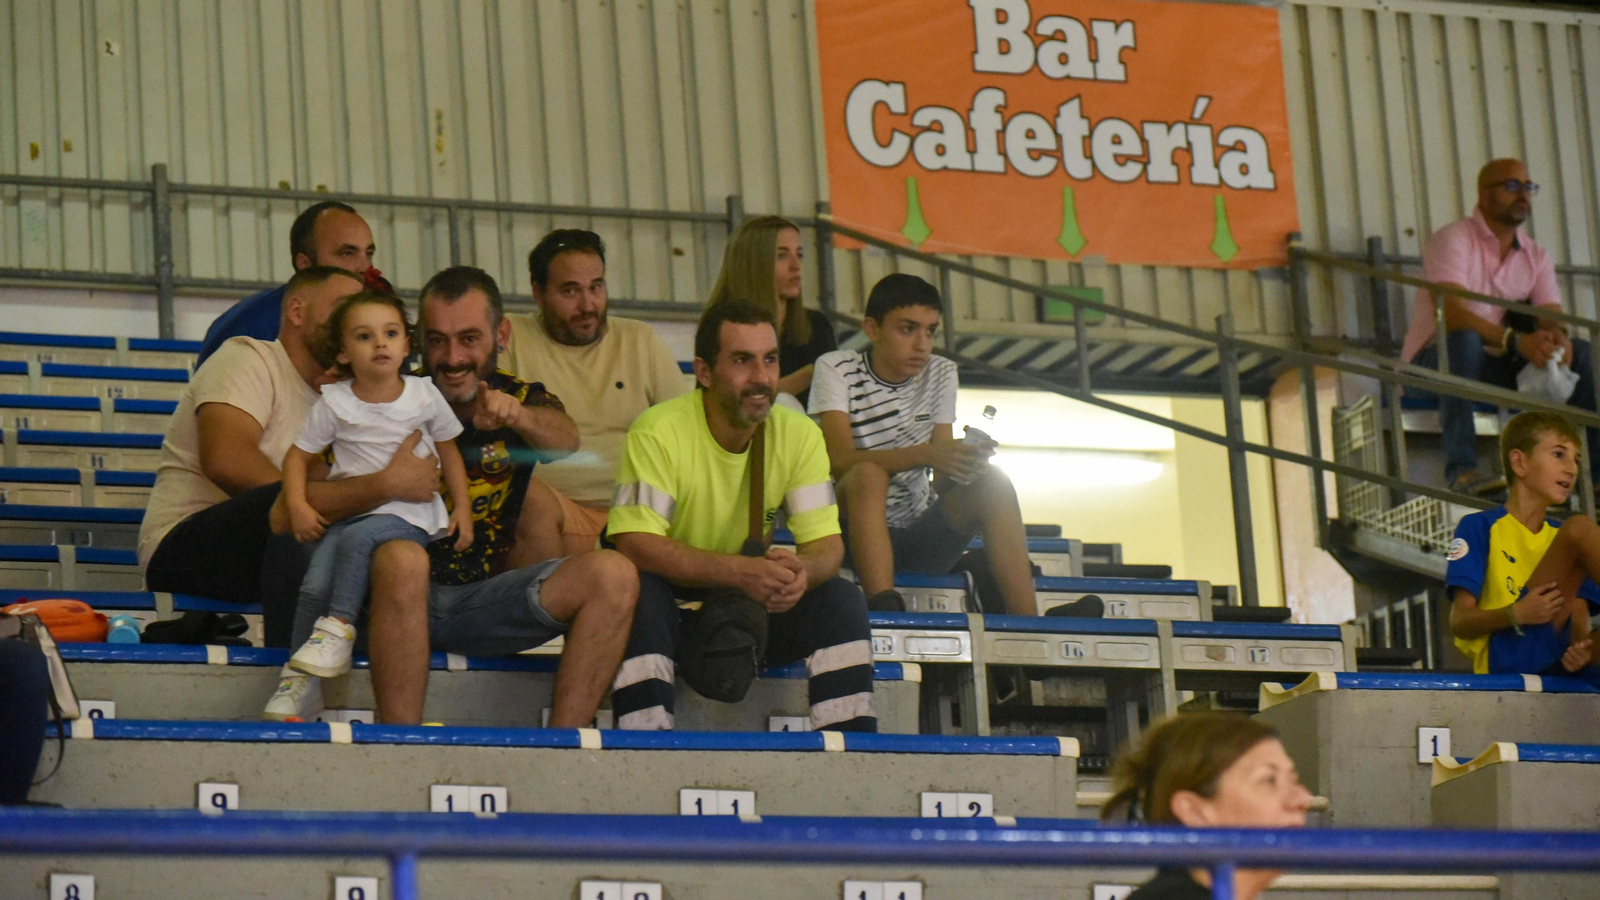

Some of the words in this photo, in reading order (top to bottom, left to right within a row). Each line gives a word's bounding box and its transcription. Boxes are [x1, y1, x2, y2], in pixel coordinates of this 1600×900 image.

[966, 0, 1136, 82] Bar
[845, 78, 1277, 191] Cafetería
[1111, 602, 1126, 616] 17
[1065, 643, 1083, 658] 16
[1250, 648, 1267, 663] 17
[1431, 734, 1439, 757] 1
[694, 797, 739, 816] 11
